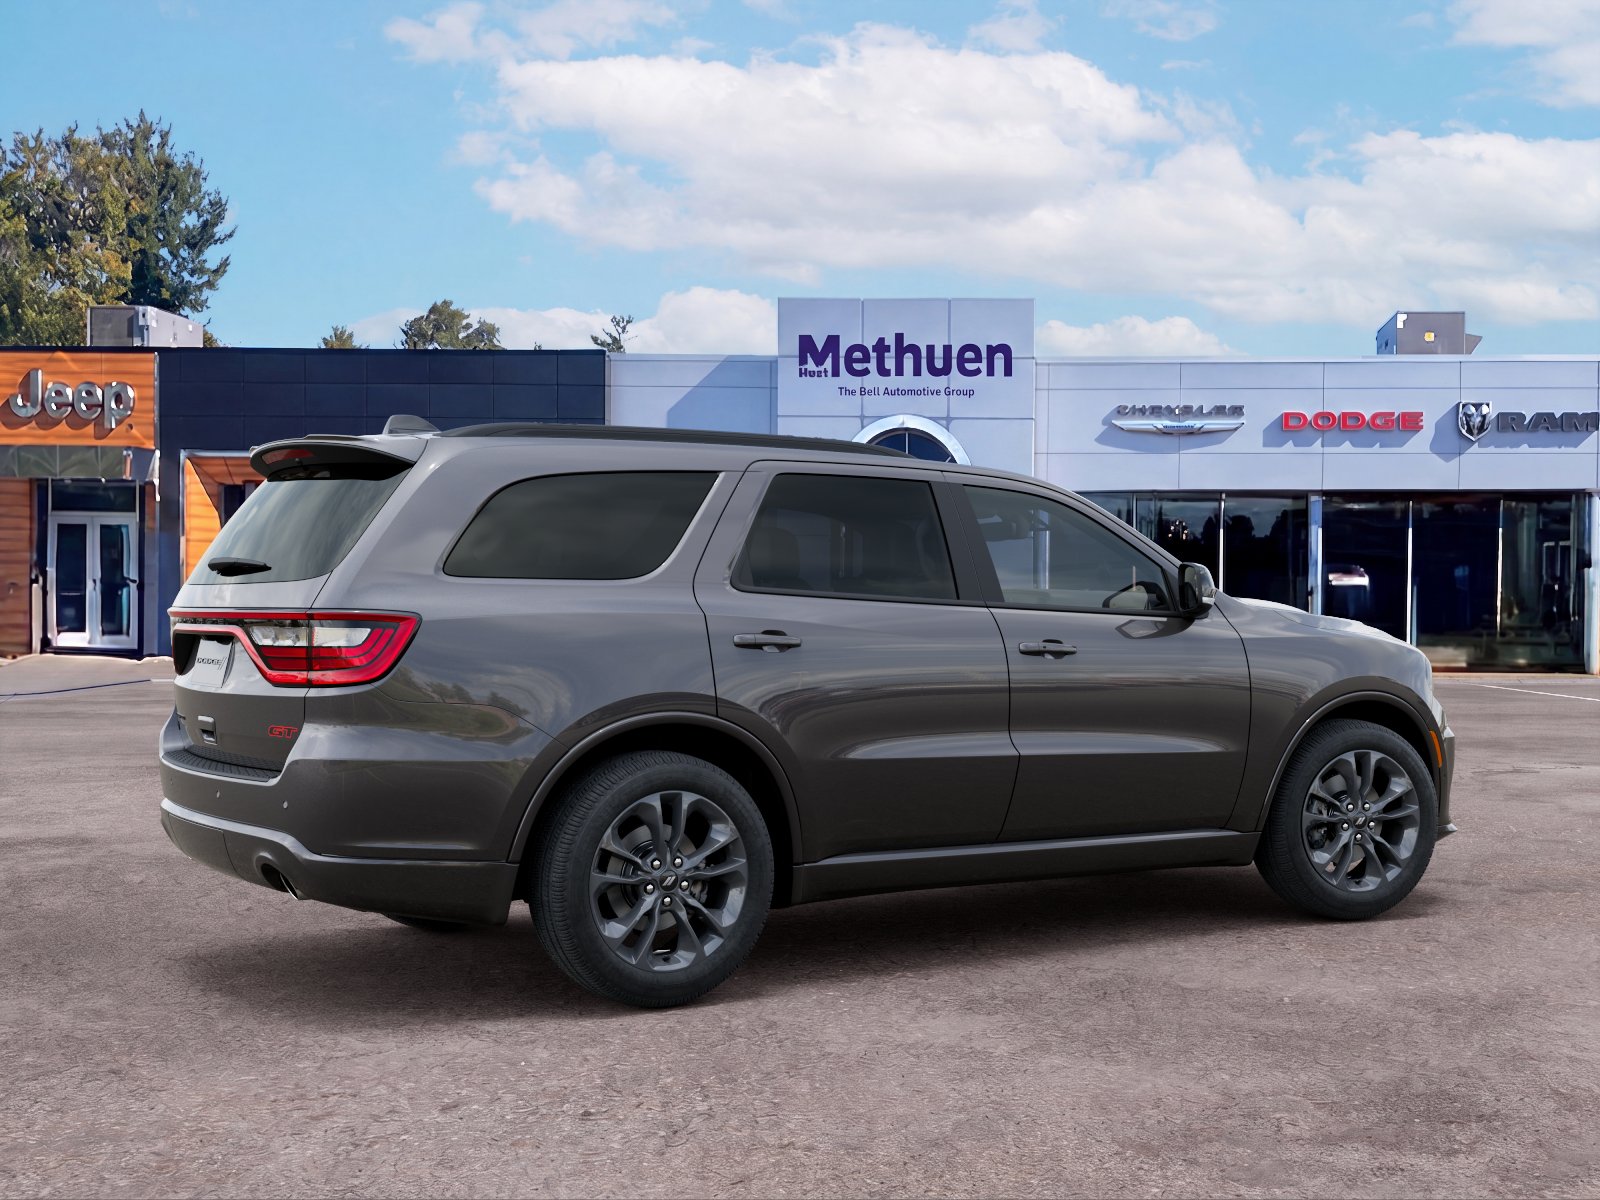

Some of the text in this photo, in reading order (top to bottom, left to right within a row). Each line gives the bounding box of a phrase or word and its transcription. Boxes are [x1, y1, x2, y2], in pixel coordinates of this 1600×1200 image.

[798, 332, 1013, 378] Methuen
[9, 368, 136, 429] Jeep
[838, 386, 975, 399] The Bell Automotive Group
[1282, 411, 1424, 431] DODGE
[1497, 411, 1600, 432] RAM
[267, 724, 299, 739] GT
